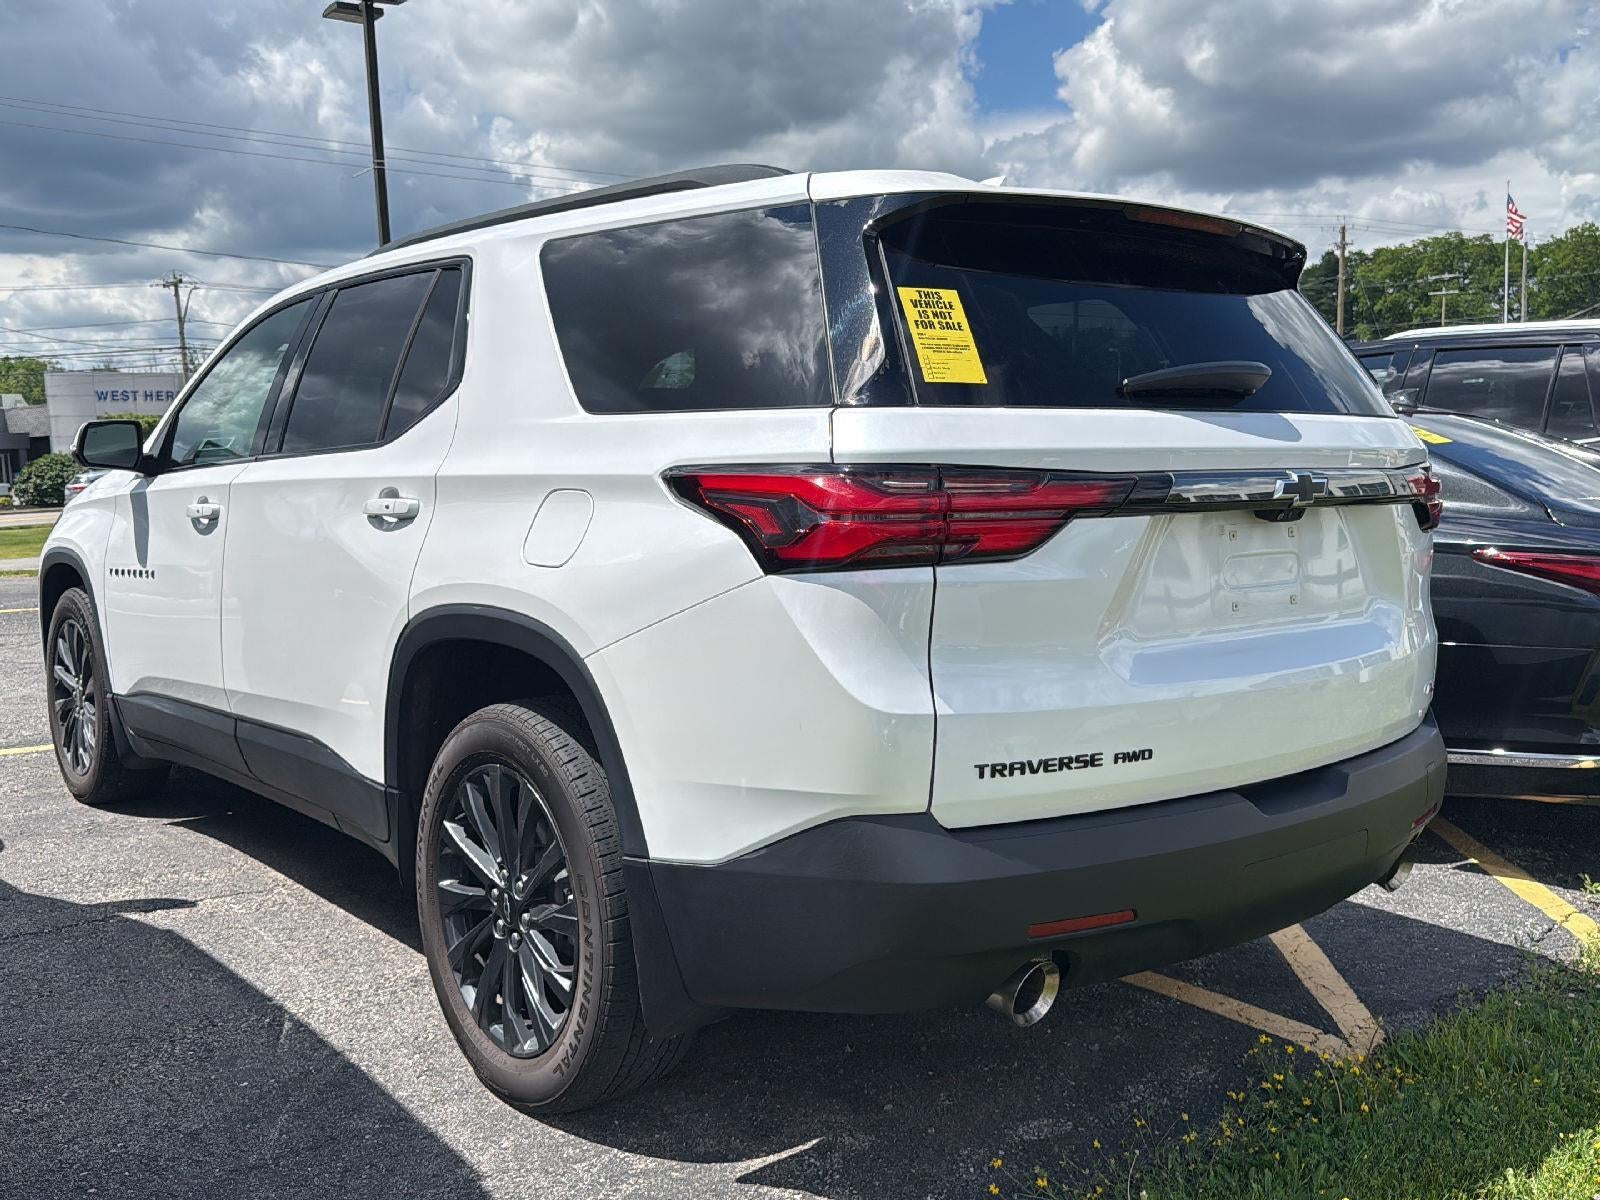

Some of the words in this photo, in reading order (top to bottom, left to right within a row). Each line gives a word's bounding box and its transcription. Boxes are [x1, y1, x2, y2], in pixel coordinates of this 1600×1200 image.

[916, 290, 942, 300] THIS
[910, 299, 955, 310] VEHICLE
[918, 310, 930, 319] IS
[931, 310, 952, 320] NOT
[914, 320, 936, 330] FOR
[938, 321, 964, 331] SALE
[96, 389, 139, 401] WEST
[145, 389, 180, 401] HER
[974, 752, 1103, 779] TRAVERSE
[1114, 749, 1153, 764] AWD
[552, 873, 594, 1077] CONTINENTAL
